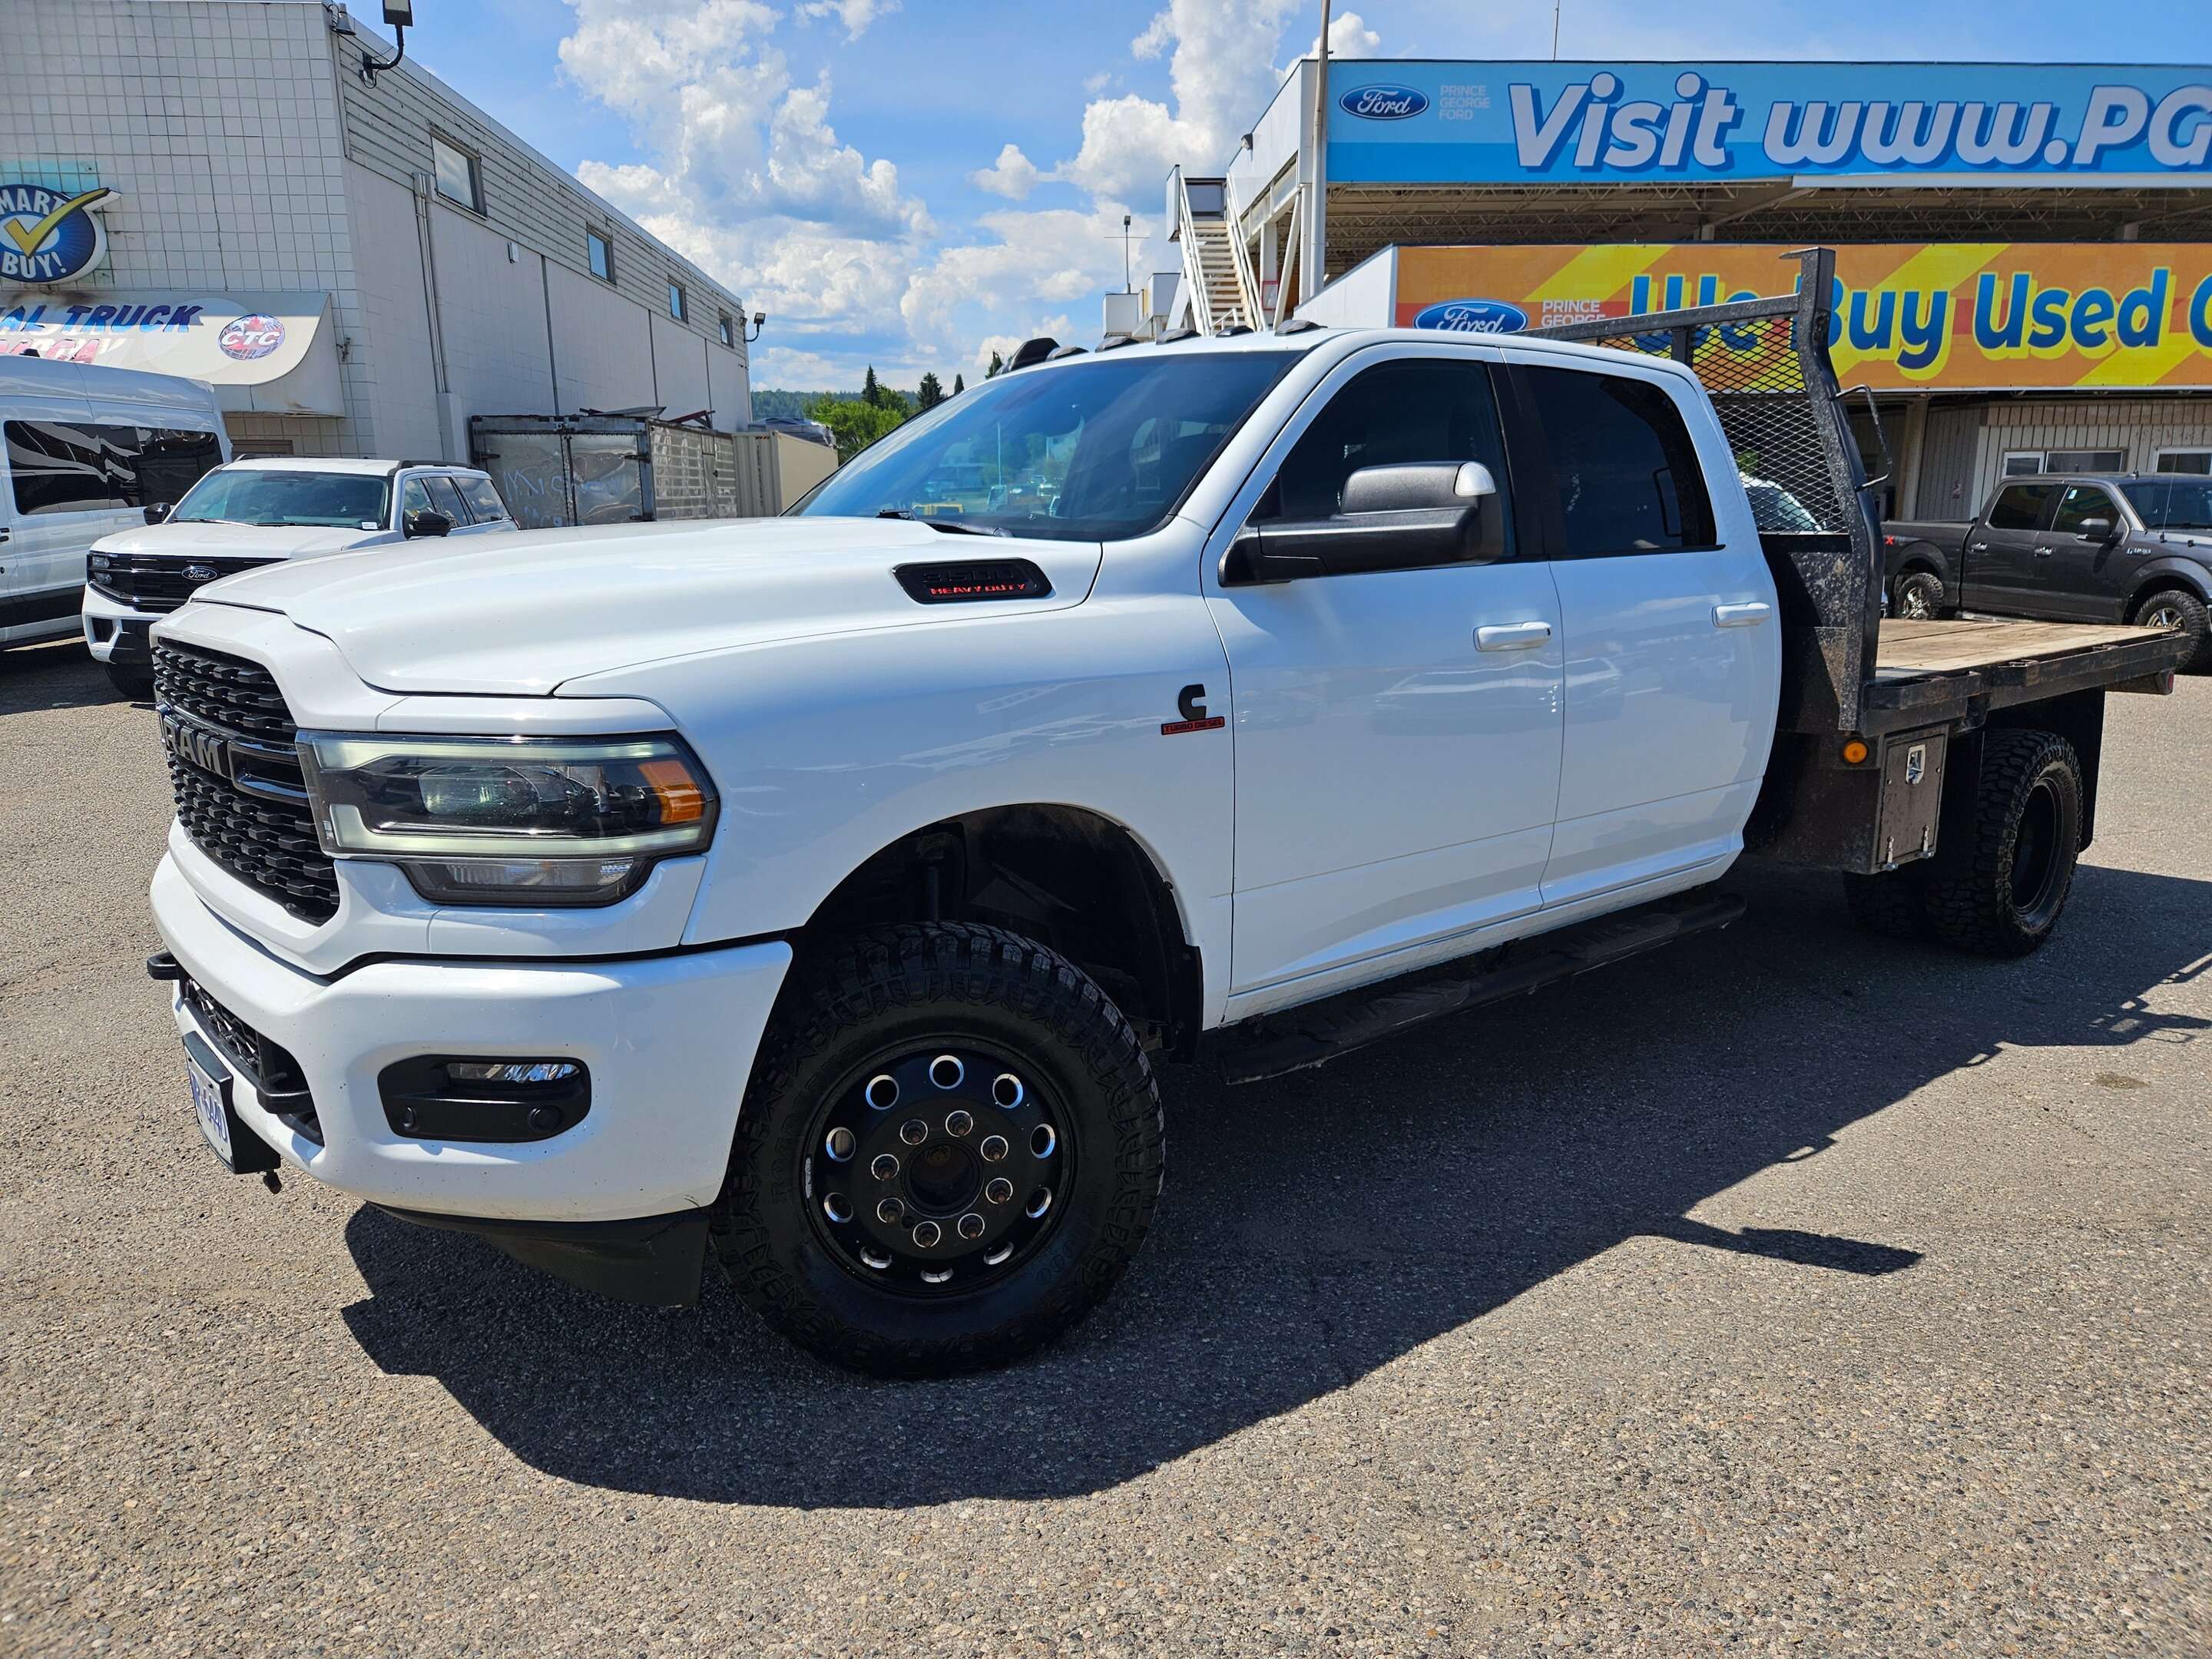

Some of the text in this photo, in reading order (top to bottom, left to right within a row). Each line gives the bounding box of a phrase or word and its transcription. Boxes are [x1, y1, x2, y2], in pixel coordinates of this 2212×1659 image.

[1439, 85, 1487, 96] PRINCE
[1356, 88, 1412, 114] Ford
[1439, 97, 1491, 108] GEORGE
[1439, 109, 1474, 121] FORD
[1507, 71, 2212, 168] Visit www.PG
[2, 251, 67, 279] BUY!
[1542, 300, 1600, 313] PRINCE
[1973, 268, 2171, 349] Used
[61, 304, 204, 333] TRUCK
[220, 330, 280, 346] CTC
[929, 583, 1027, 595] HEAVY DUTY
[1164, 722, 1194, 733] TURBO
[163, 715, 230, 779] RAM
